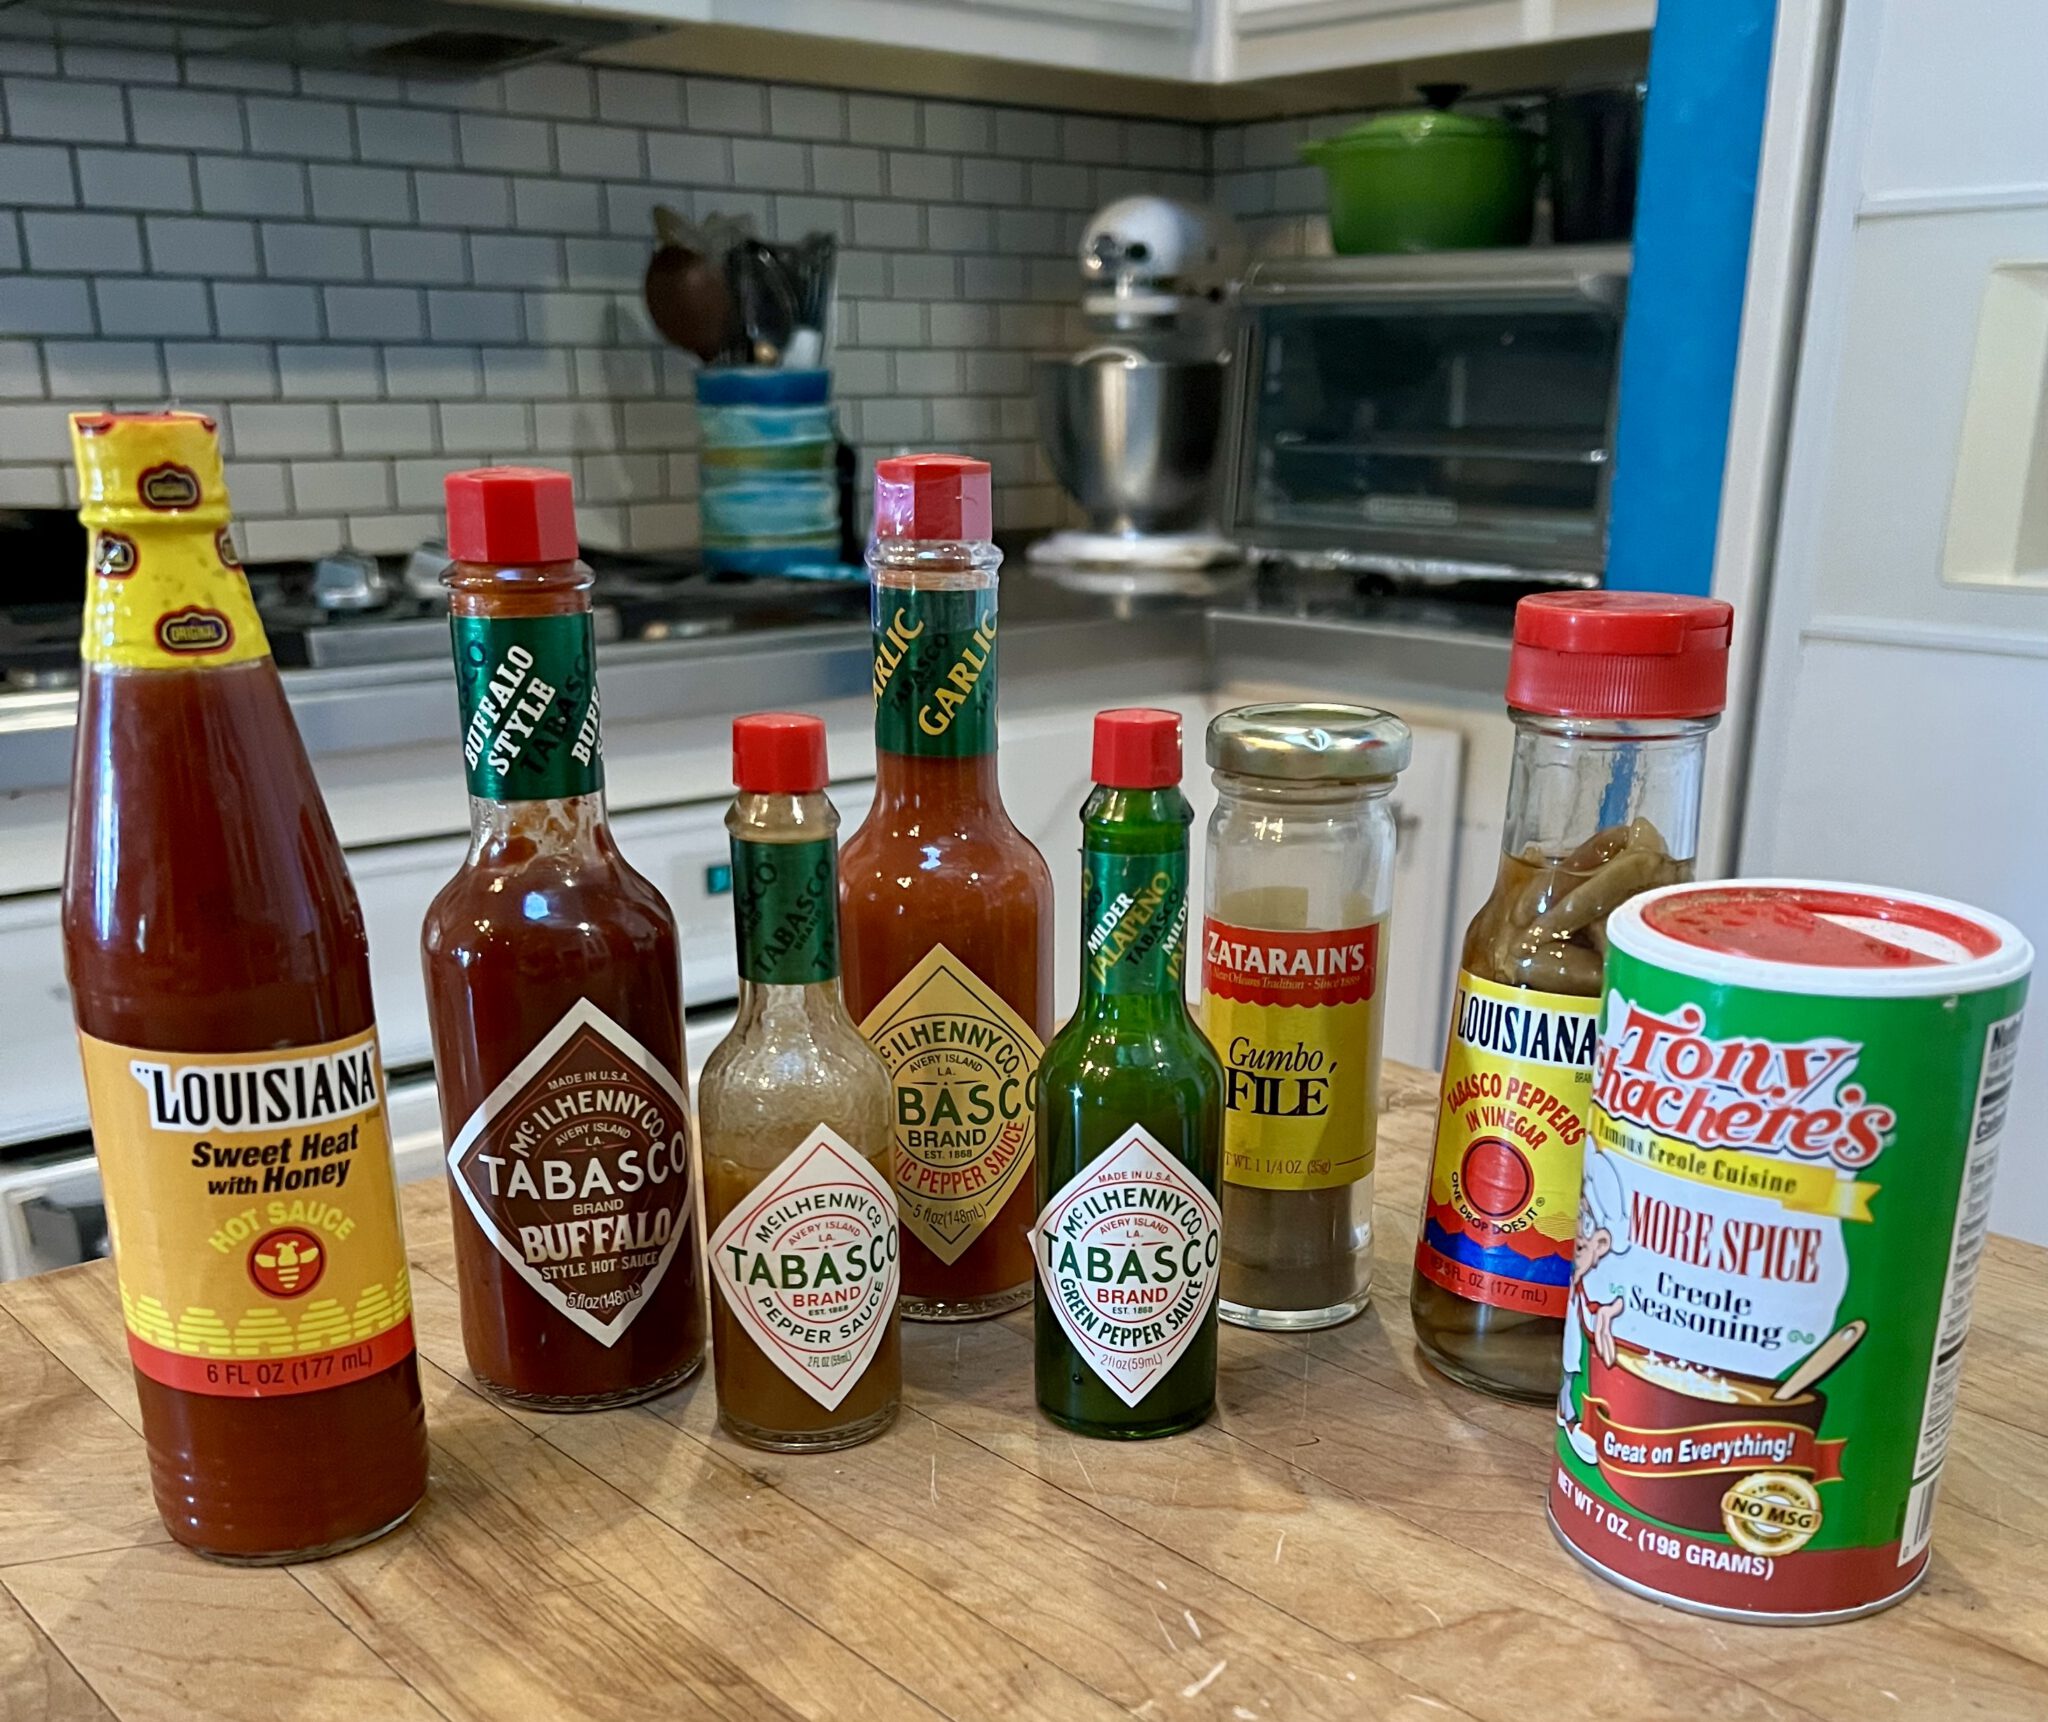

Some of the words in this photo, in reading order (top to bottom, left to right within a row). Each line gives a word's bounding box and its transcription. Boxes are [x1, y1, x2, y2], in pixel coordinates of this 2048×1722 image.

[918, 609, 998, 736] GARLIC
[464, 645, 534, 771] BUFFALO
[487, 676, 556, 776] STYLE
[1087, 892, 1134, 956] MILDER
[1206, 931, 1366, 977] ZATARAIN'S
[1457, 989, 1597, 1066] LOUISIANA
[909, 1053, 942, 1073] AVERY
[945, 1053, 984, 1073] ISLAND
[1229, 1036, 1324, 1072] Gumbo
[1621, 1008, 1857, 1098] Tony
[547, 1073, 582, 1090] MADE
[585, 1071, 597, 1081] IN
[898, 1069, 1037, 1127] BASCO
[1446, 1072, 1502, 1115] TABASCO
[1505, 1076, 1587, 1146] PEPPERS
[1465, 1108, 1482, 1133] IN
[1481, 1105, 1548, 1151] VINEGAR
[191, 1138, 292, 1168] Sweet
[301, 1123, 359, 1161] Heat
[555, 1123, 590, 1147] AVERY
[593, 1122, 631, 1139] ISLAND
[908, 1128, 987, 1148] BRAND
[917, 1165, 986, 1196] PEPPER
[984, 1120, 1026, 1176] SAUCE
[208, 1176, 258, 1195] with
[263, 1159, 351, 1193] Honey
[478, 1130, 686, 1201] TABASCO
[1098, 1172, 1128, 1183] MADE
[1131, 1170, 1142, 1179] IN
[1648, 1140, 1707, 1177] Creole
[1712, 1160, 1798, 1194] Cuisine
[208, 1208, 261, 1254] HOT
[266, 1199, 357, 1241] SAUCE
[573, 1198, 625, 1216] BRAND
[1099, 1216, 1131, 1235] AVERY
[1134, 1217, 1169, 1235] ISLAND
[1452, 1171, 1462, 1202] ONE
[1459, 1204, 1488, 1232] DROP
[1492, 1217, 1527, 1235] DOES
[1525, 1207, 1539, 1221] IT
[518, 1207, 672, 1264] BUFFALO
[726, 1224, 898, 1290] TABASCO
[788, 1223, 822, 1246] AVERY
[825, 1220, 861, 1237] ISLAND
[1043, 1227, 1219, 1286] TABASCO
[1628, 1190, 1714, 1269] MORE
[1717, 1218, 1822, 1284] SPICE
[541, 1262, 587, 1281] STYLE
[591, 1258, 618, 1274] HOT
[621, 1250, 659, 1270] SAUCE
[1468, 1272, 1486, 1290] OZ
[1490, 1281, 1519, 1297] (177
[1521, 1289, 1549, 1306] mL)
[757, 1295, 832, 1344] PEPPER
[840, 1280, 885, 1340] SAUCE
[792, 1285, 861, 1308] BRAND
[1060, 1277, 1100, 1333] GREEN
[1097, 1321, 1166, 1348] PEPPER
[1168, 1278, 1203, 1332] SAUCE
[1097, 1287, 1169, 1305] BRAND
[1628, 1283, 1783, 1352] Seasoning
[1657, 1271, 1753, 1316] Creole
[207, 1364, 218, 1384] 6
[226, 1364, 250, 1386] FL
[257, 1362, 285, 1385] OZ
[291, 1355, 334, 1383] (177
[342, 1348, 374, 1370] mL)
[1603, 1431, 1648, 1464] Great
[1651, 1442, 1673, 1464] on
[1677, 1431, 1797, 1465] Everything!
[1574, 1486, 1595, 1516] WT
[1595, 1503, 1605, 1523] 7
[1606, 1512, 1634, 1542] OZ.
[1638, 1528, 1681, 1560] (198
[1685, 1546, 1775, 1581] GRAMS)
[1731, 1497, 1764, 1517] NO
[1766, 1507, 1813, 1529] MSG
